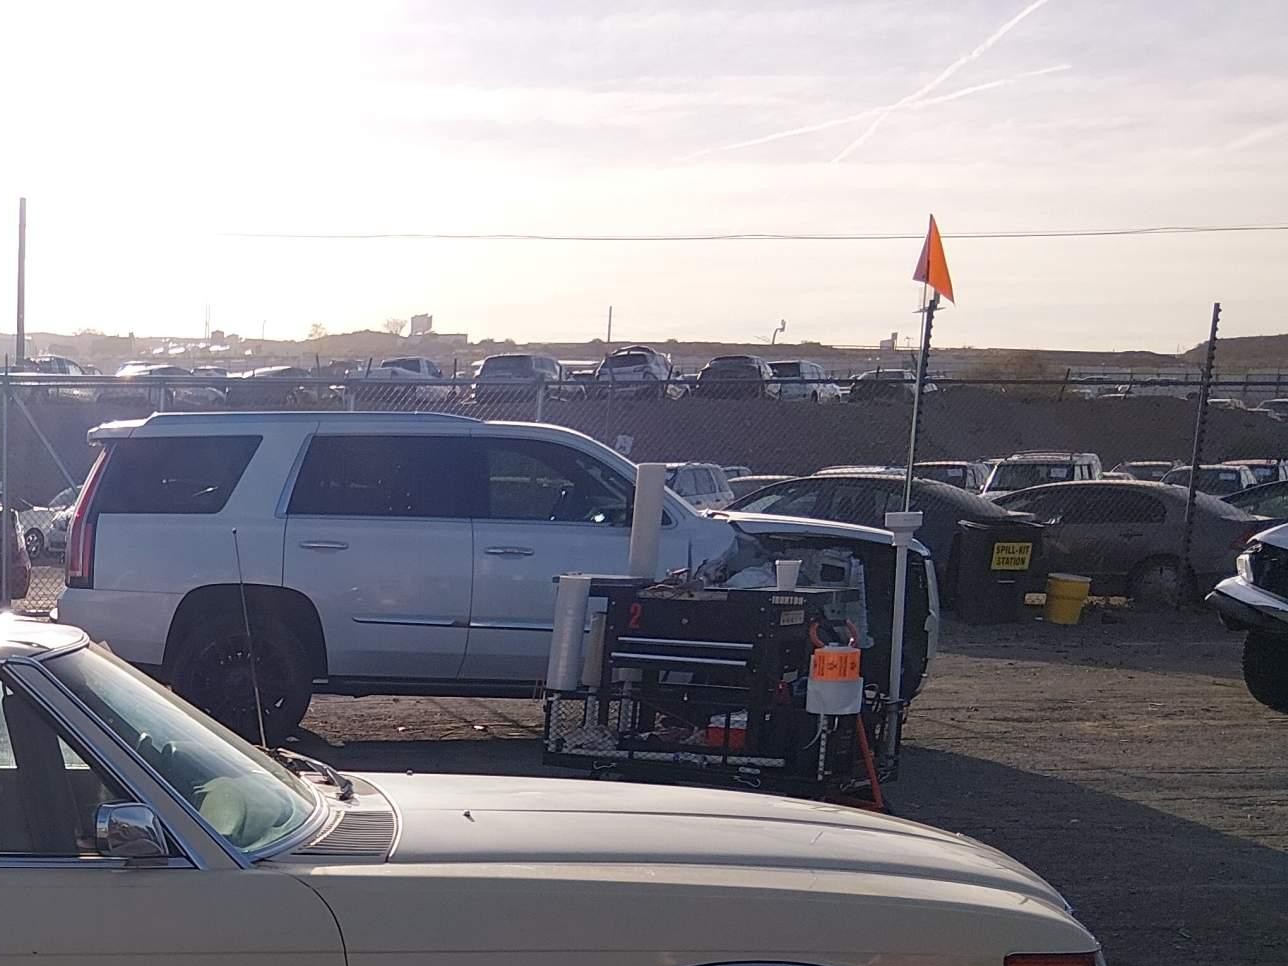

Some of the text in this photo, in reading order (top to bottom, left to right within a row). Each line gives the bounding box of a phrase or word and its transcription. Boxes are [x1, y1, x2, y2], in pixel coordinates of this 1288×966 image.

[995, 544, 1030, 555] SPILL-KIT
[995, 556, 1026, 567] STATION
[629, 602, 642, 629] 2
